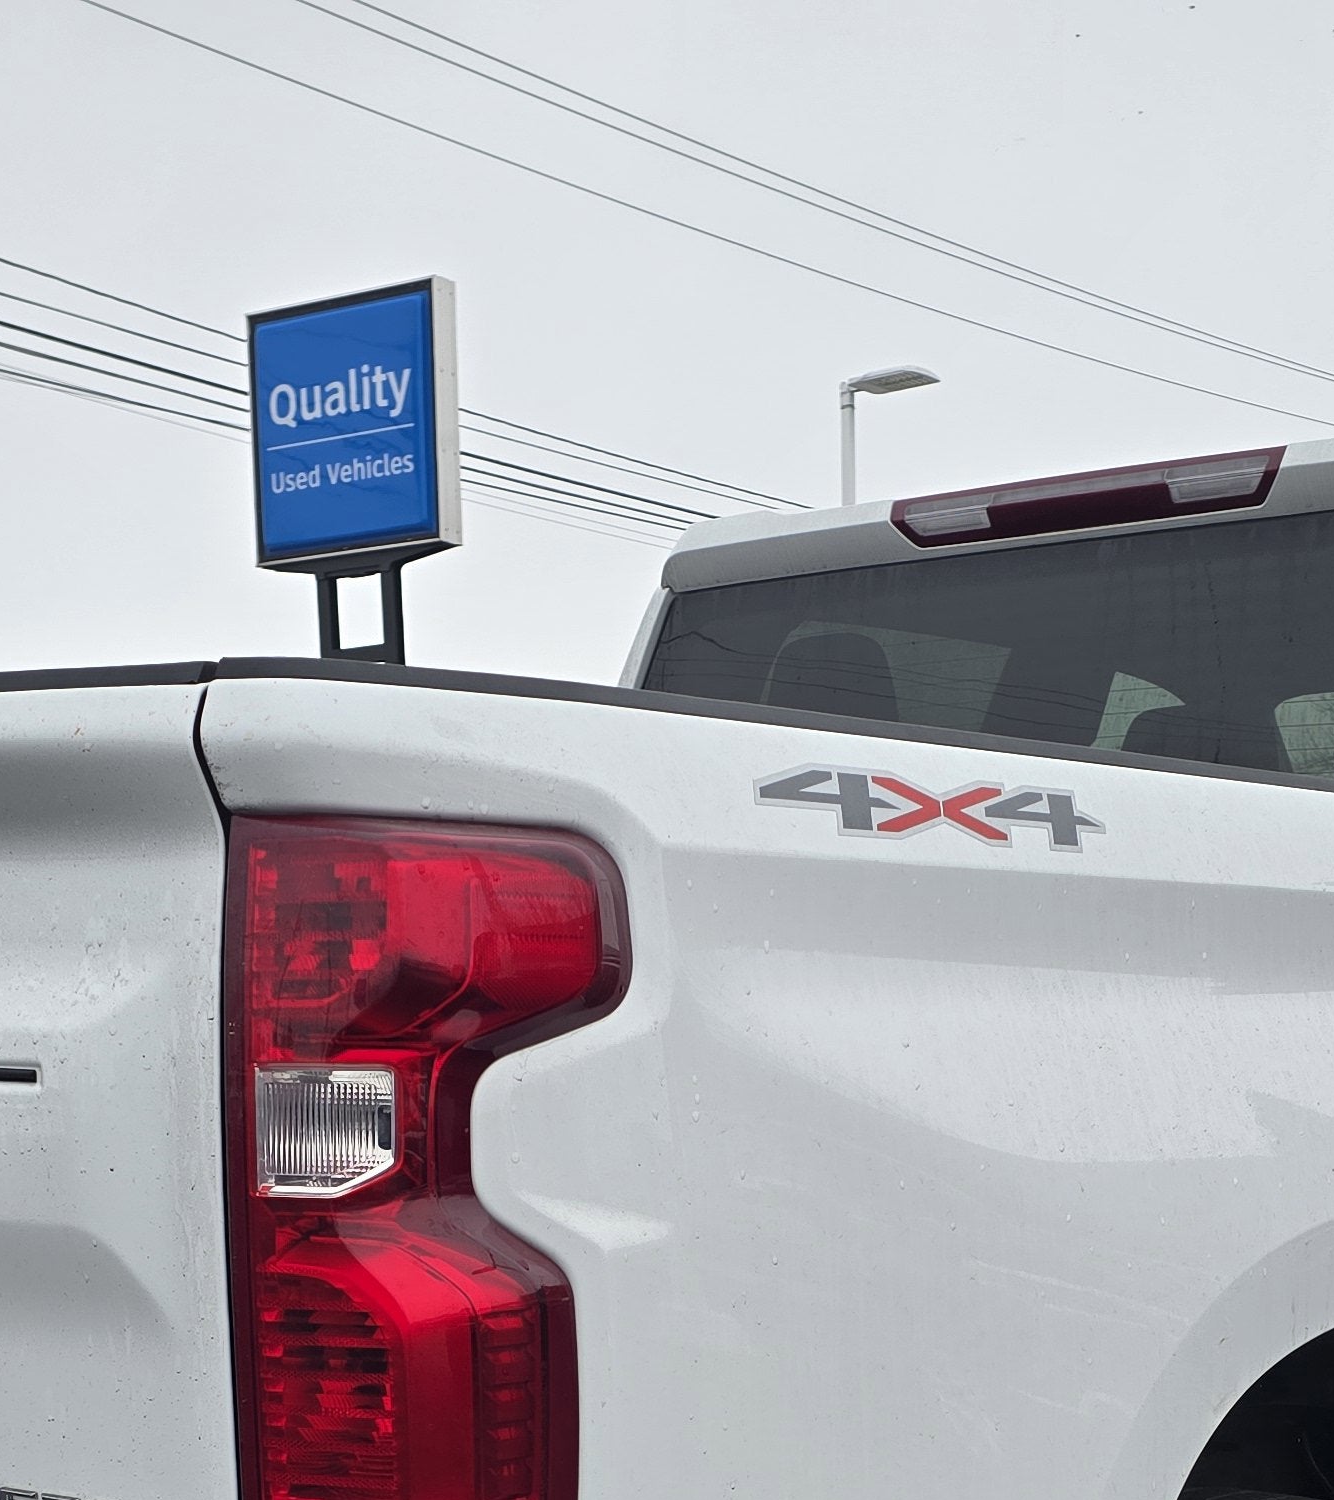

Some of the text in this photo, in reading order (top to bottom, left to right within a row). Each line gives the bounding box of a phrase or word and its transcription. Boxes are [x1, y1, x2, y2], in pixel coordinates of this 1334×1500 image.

[270, 364, 411, 428] Quality
[270, 453, 414, 494] Used Vehicles
